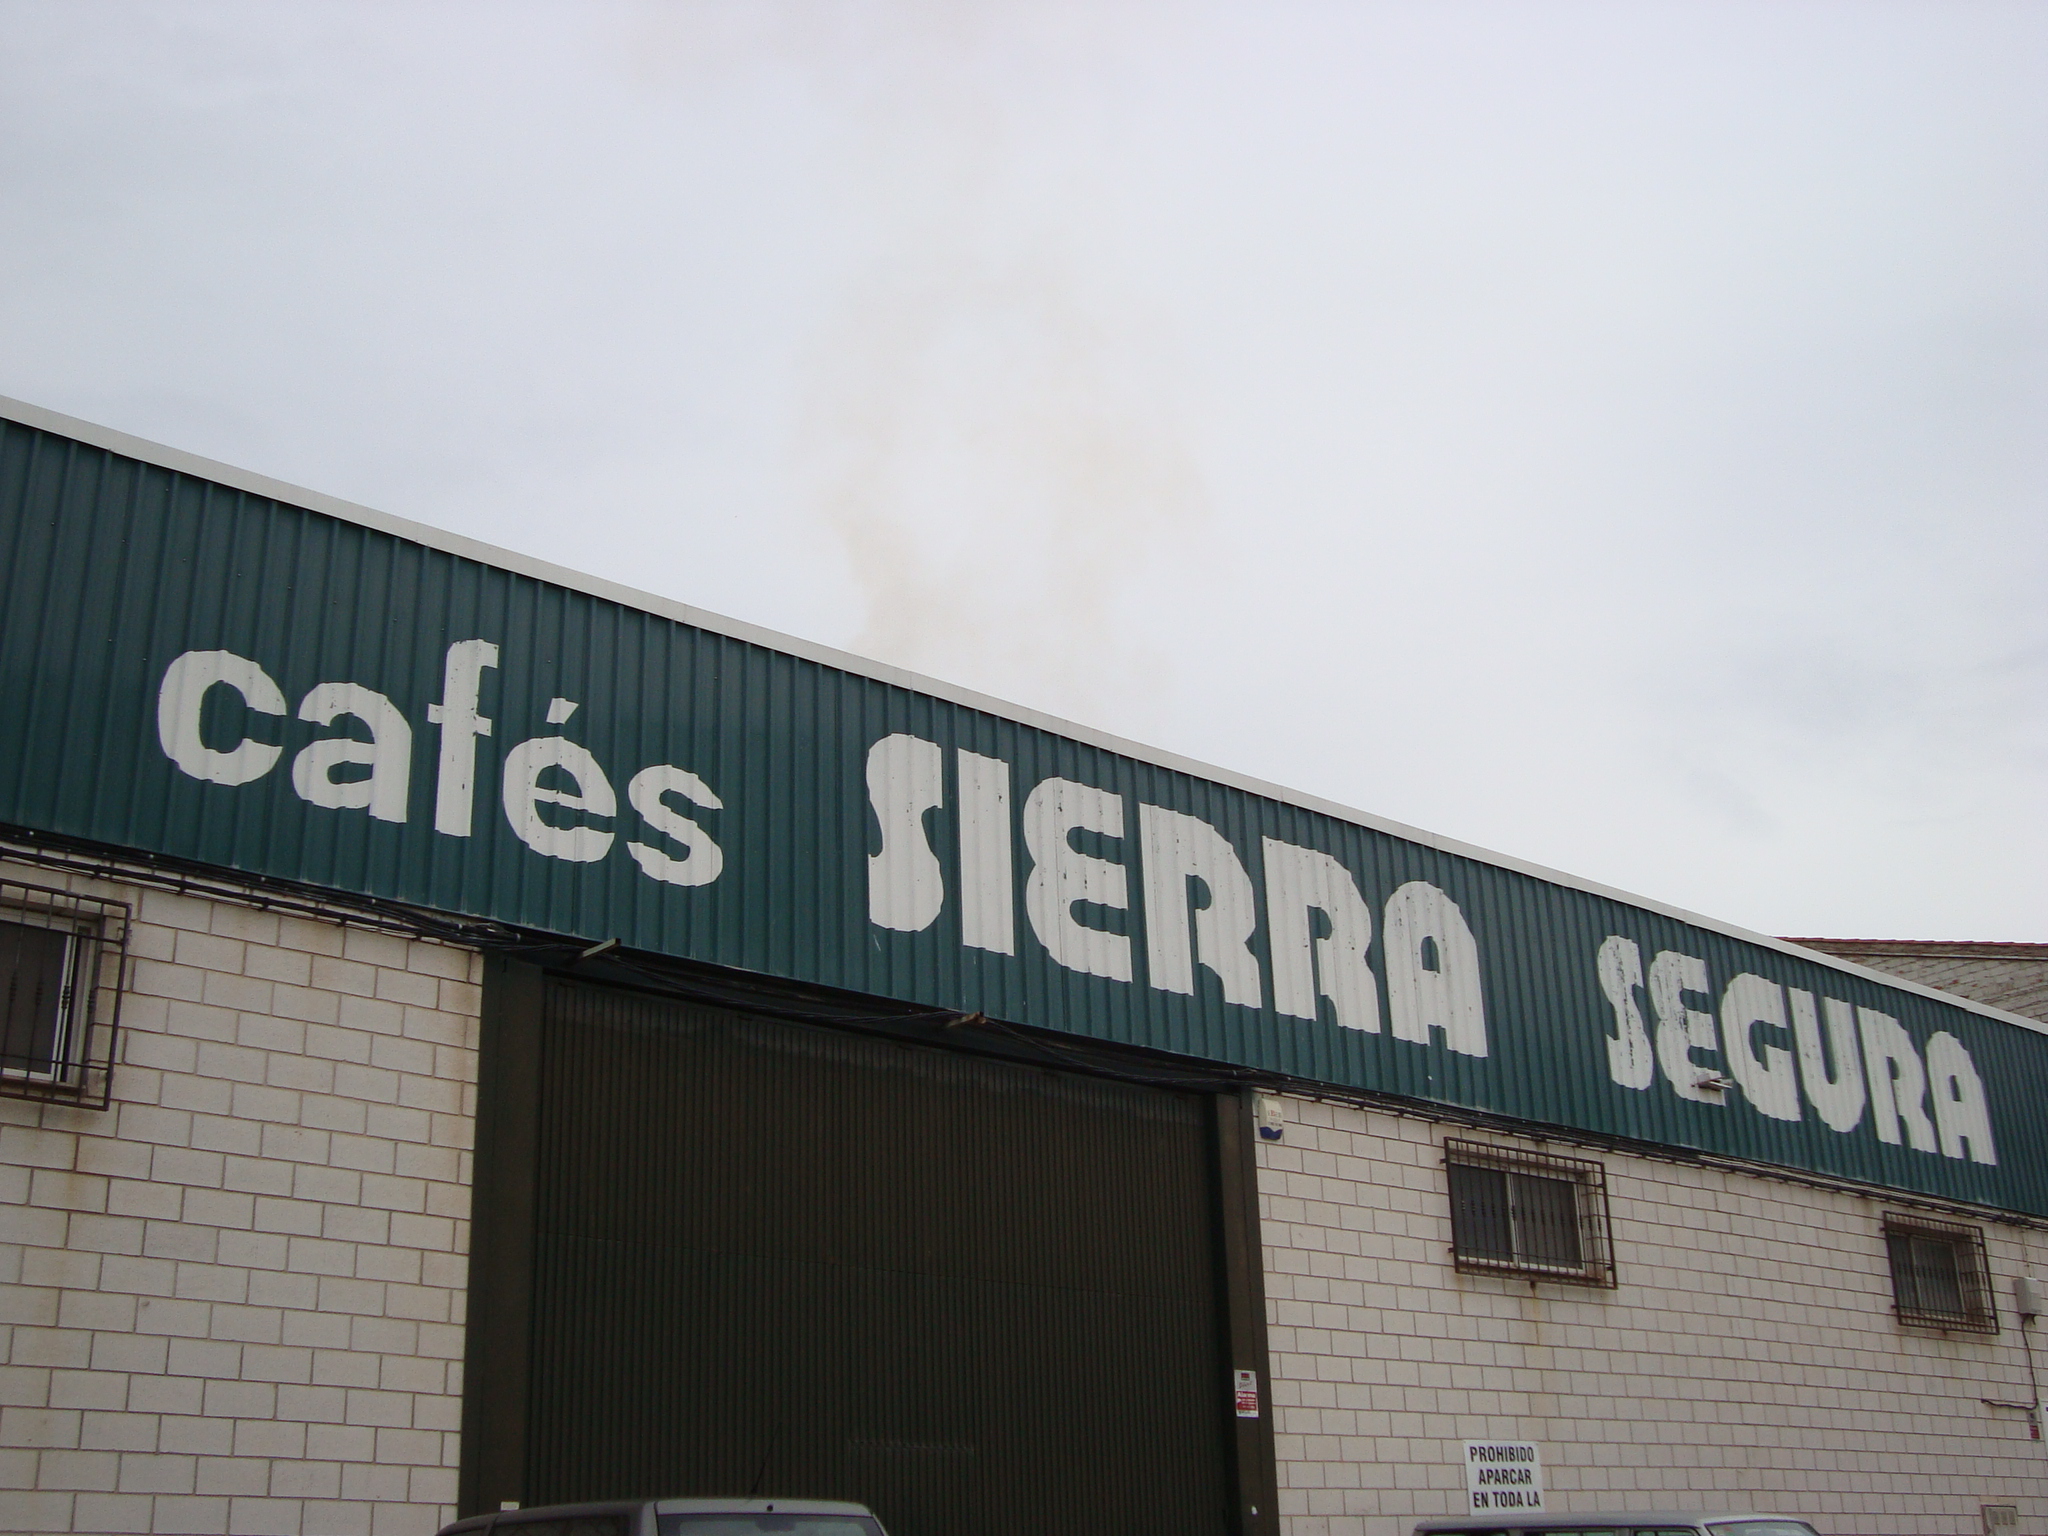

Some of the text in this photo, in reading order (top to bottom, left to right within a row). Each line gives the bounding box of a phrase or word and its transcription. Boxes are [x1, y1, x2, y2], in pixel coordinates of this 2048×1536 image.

[157, 638, 1997, 1165] cafés SIERRA SEGURA
[1469, 1446, 1534, 1462] PROHIBIDO
[1479, 1468, 1532, 1485] APARCAR
[1473, 1491, 1541, 1508] EN TODA LA
